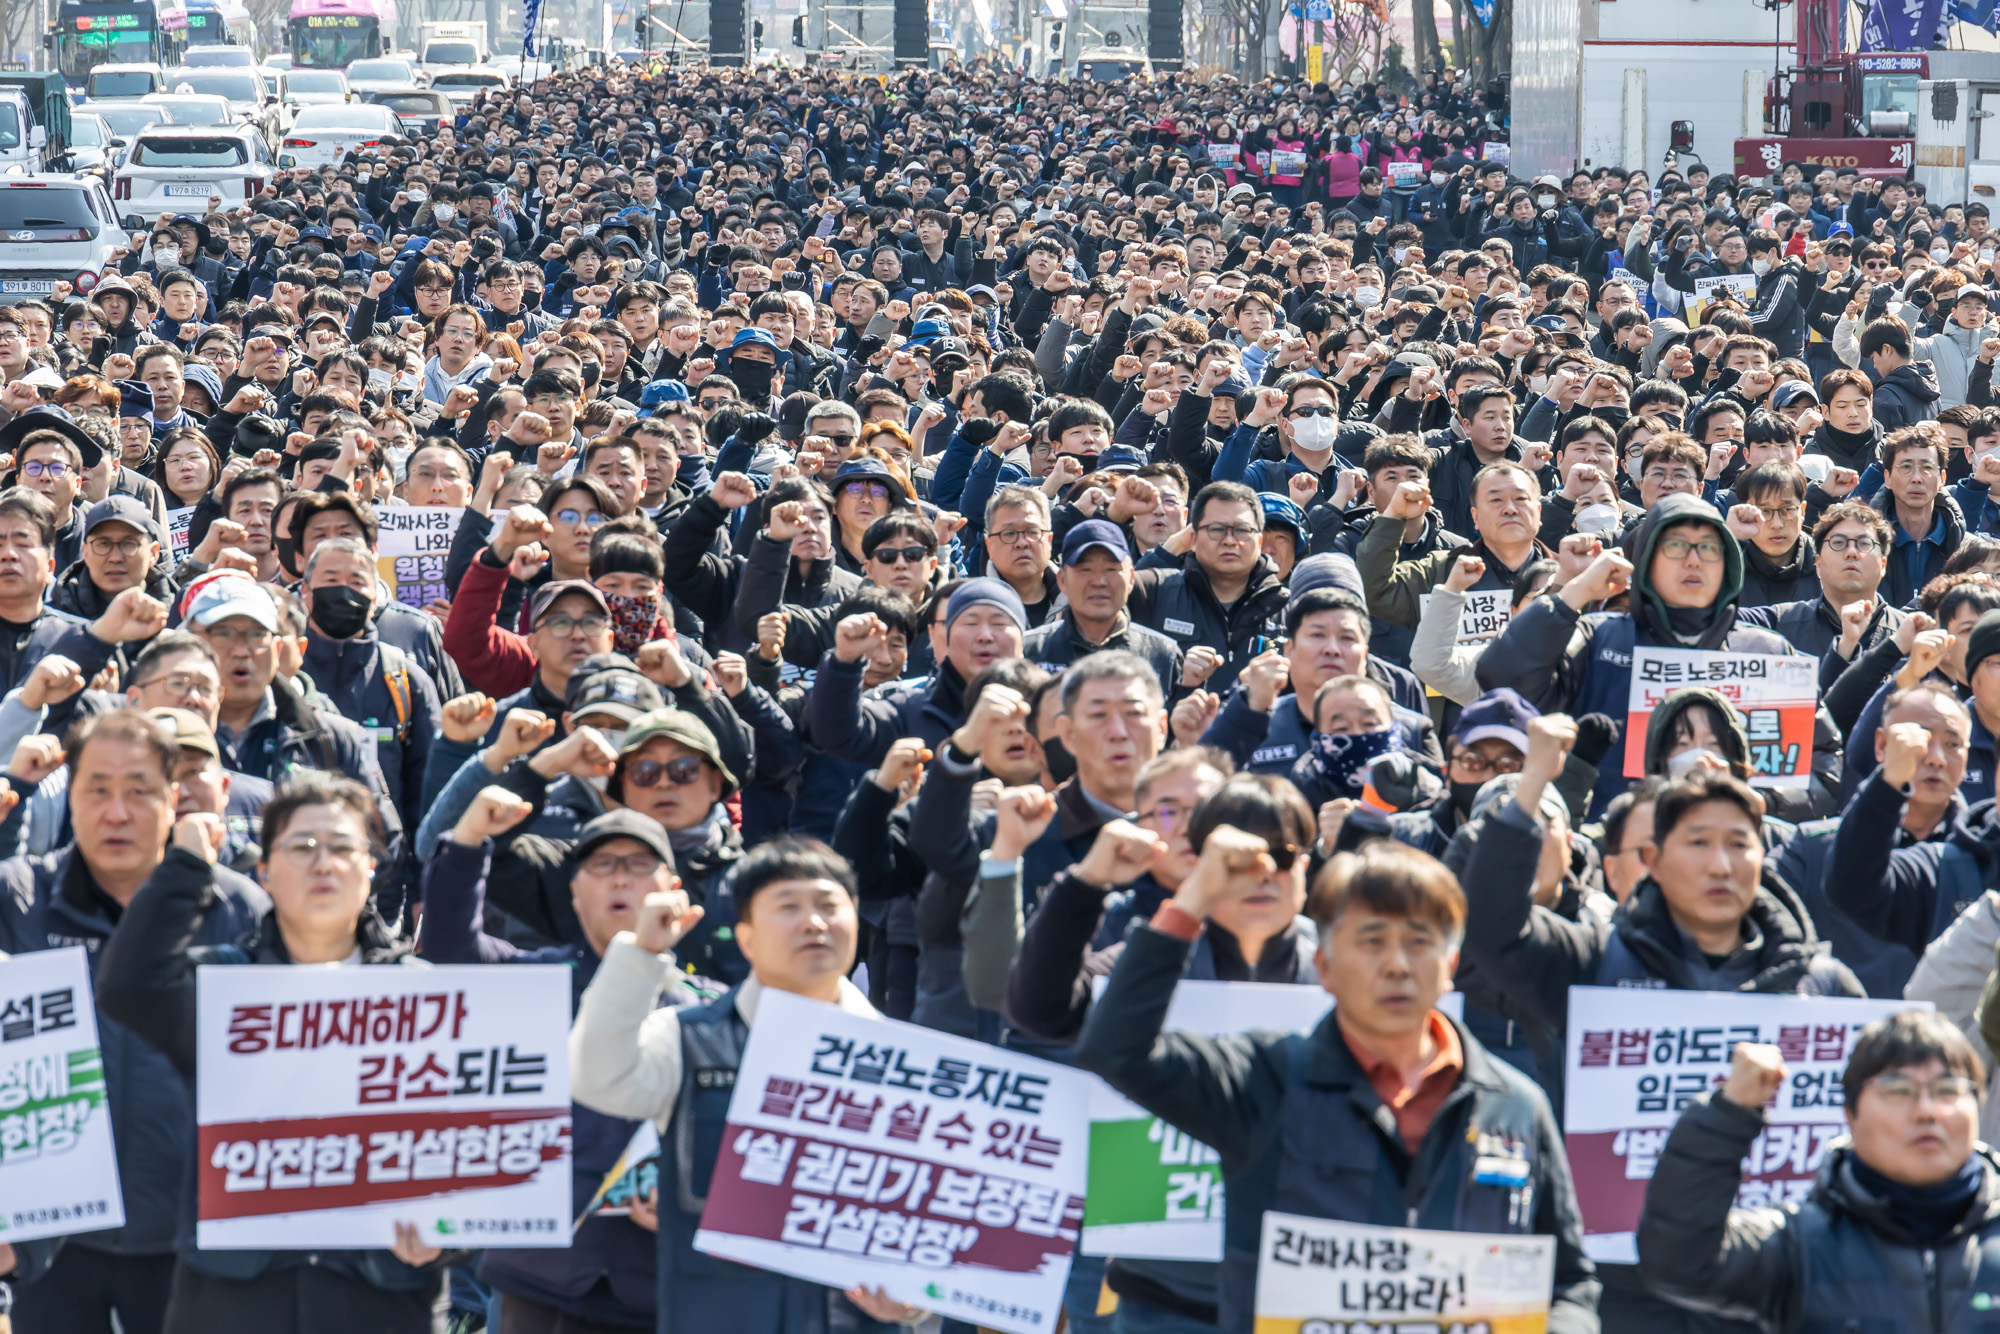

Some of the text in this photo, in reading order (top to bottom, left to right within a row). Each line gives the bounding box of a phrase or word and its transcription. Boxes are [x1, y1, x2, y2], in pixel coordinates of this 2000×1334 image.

[1759, 142, 1912, 169] 형 제
[1805, 155, 1859, 167] KATO
[190, 186, 210, 195] 8219
[30, 281, 53, 292] 8011
[378, 511, 451, 532] 진짜사장
[415, 533, 453, 551] 나와
[395, 555, 448, 582] 원청
[1463, 595, 1497, 614] 사장
[1640, 658, 1767, 683] 모든 노동자의
[1748, 743, 1800, 776] 자!
[228, 990, 468, 1053] 중대재해가
[358, 1045, 548, 1104] 감소되는
[809, 1033, 1051, 1115] 건설노동자도
[759, 1074, 1063, 1171] 빨간날 쉴 수 있는
[211, 1132, 363, 1193] ‘안전한
[732, 1129, 797, 1187] ‘쉴
[792, 1140, 934, 1210] 권리가
[926, 1167, 1071, 1238] 보장된
[1272, 1227, 1411, 1273] 진짜사장
[1340, 1272, 1468, 1314] 나와라!
